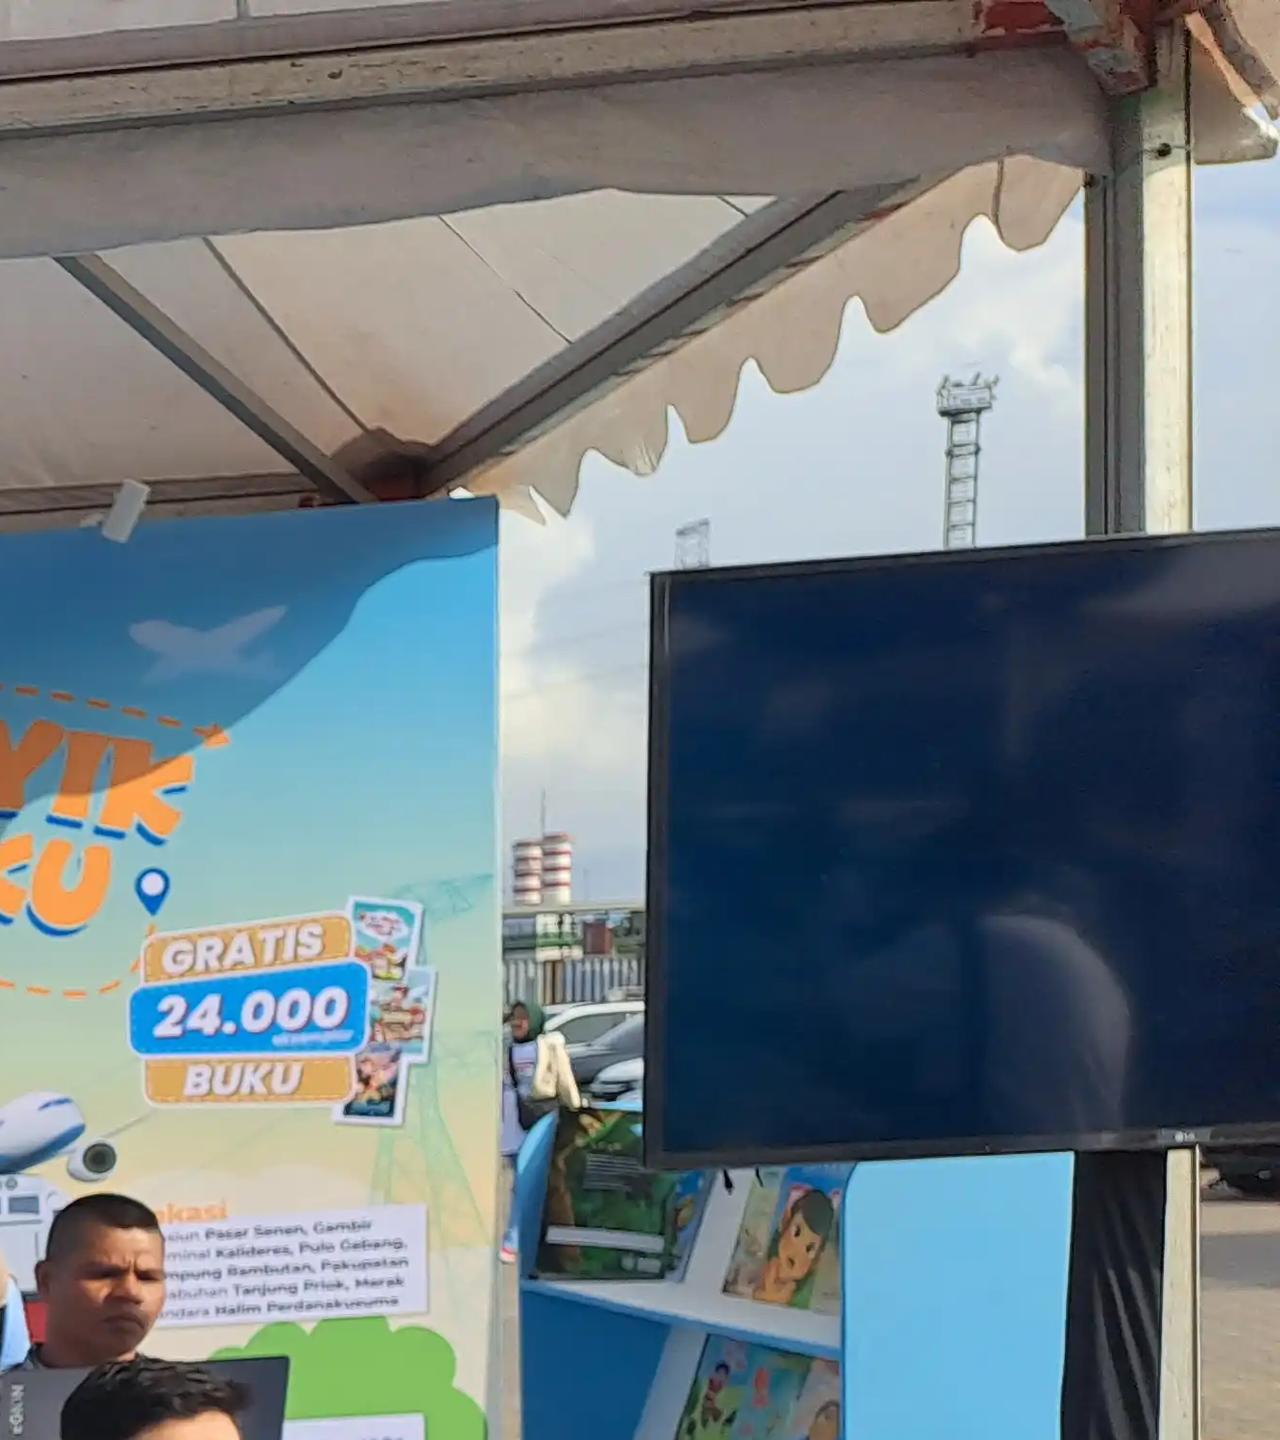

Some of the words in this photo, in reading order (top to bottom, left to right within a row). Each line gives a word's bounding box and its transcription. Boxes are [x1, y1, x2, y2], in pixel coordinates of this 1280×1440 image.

[161, 922, 326, 975] GRATIS
[152, 985, 350, 1040] 24.000
[183, 1062, 304, 1098] BUKU
[313, 1218, 373, 1235] Gambir
[233, 1281, 298, 1299] Tanjung
[215, 1302, 262, 1317] Halim
